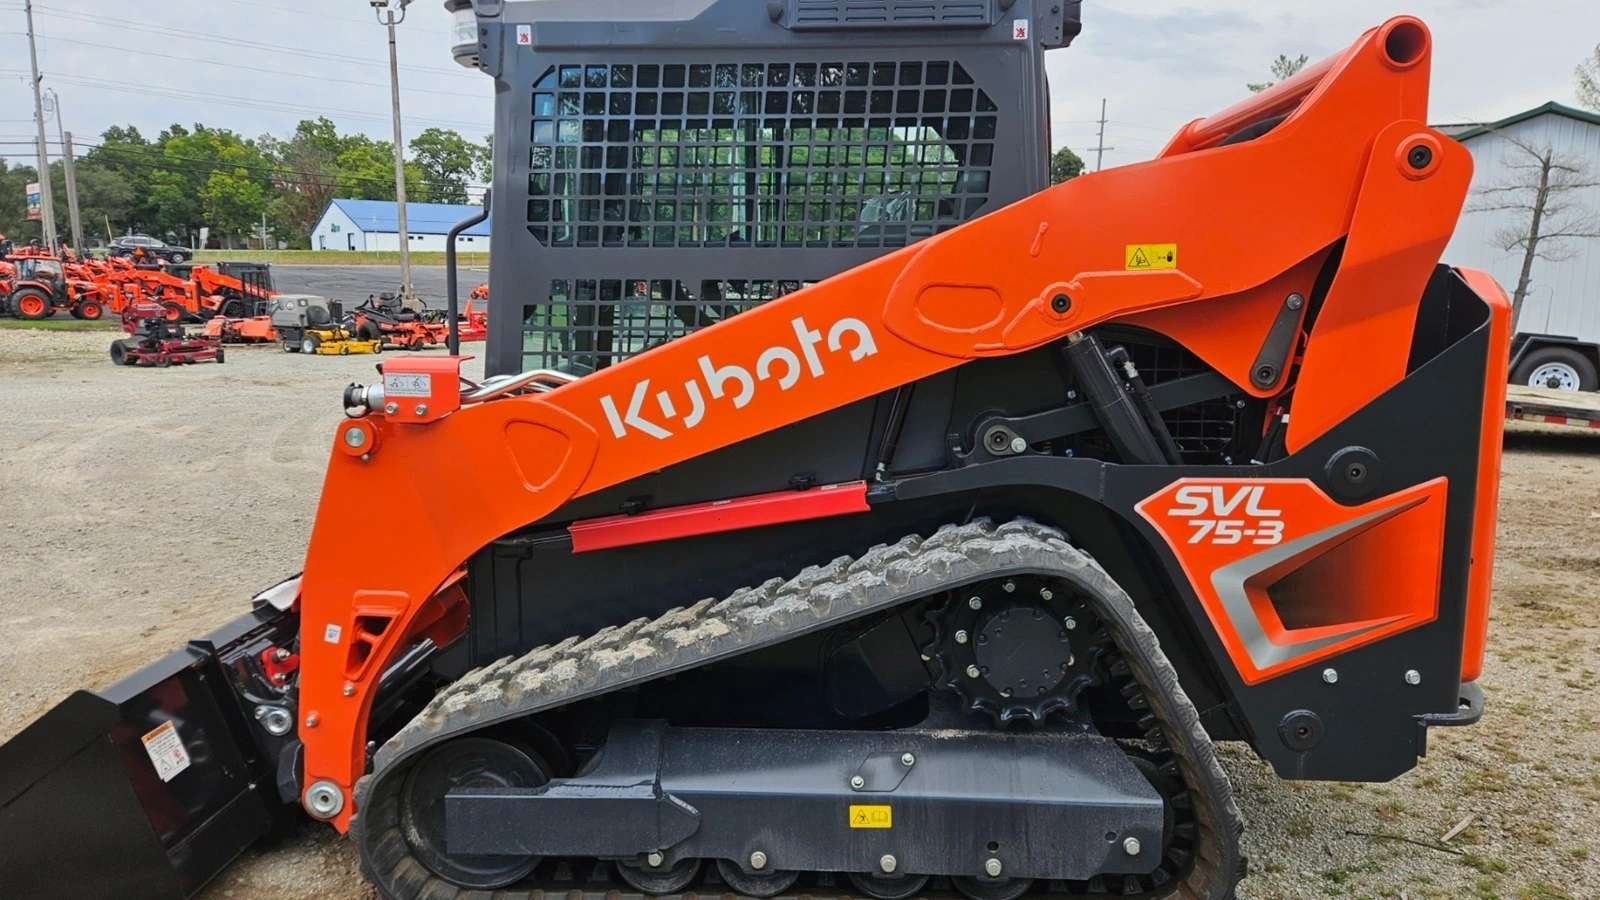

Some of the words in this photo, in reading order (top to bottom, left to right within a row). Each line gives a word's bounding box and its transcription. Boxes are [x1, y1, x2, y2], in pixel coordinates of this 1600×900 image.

[600, 317, 878, 440] Kubota
[1167, 486, 1282, 517] SVL
[1187, 520, 1285, 545] 75-3
